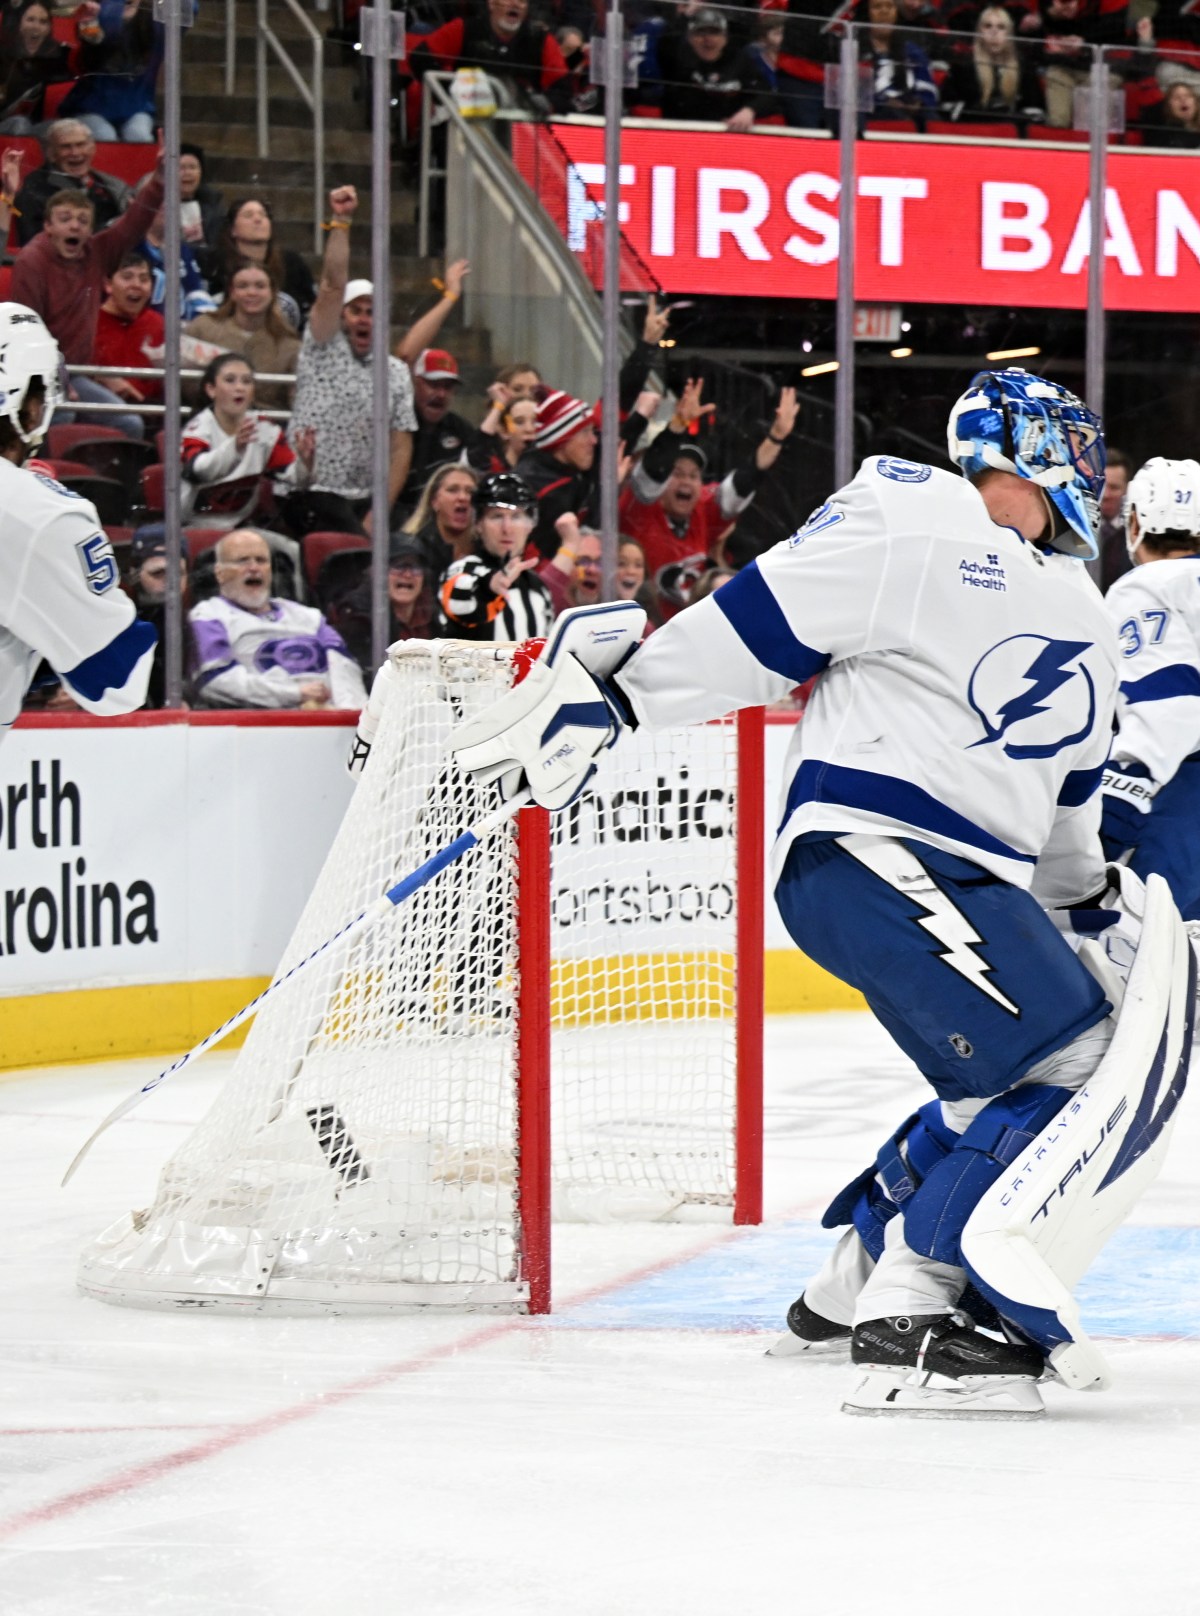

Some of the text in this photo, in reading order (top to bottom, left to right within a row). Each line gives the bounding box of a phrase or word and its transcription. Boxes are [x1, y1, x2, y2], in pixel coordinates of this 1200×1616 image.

[567, 163, 928, 267] FIRST
[1174, 490, 1193, 505] 37
[75, 530, 119, 596] 5
[959, 559, 1005, 579] Advent
[962, 573, 1006, 592] Health
[1117, 607, 1170, 659] 37
[0, 759, 82, 850] rth
[551, 764, 736, 846] natic
[0, 856, 159, 957] rolina
[552, 869, 734, 927] ortsboo
[1000, 1086, 1089, 1206] CATALYST
[1030, 1095, 1127, 1224] TRUE
[860, 1330, 907, 1356] BAUER
